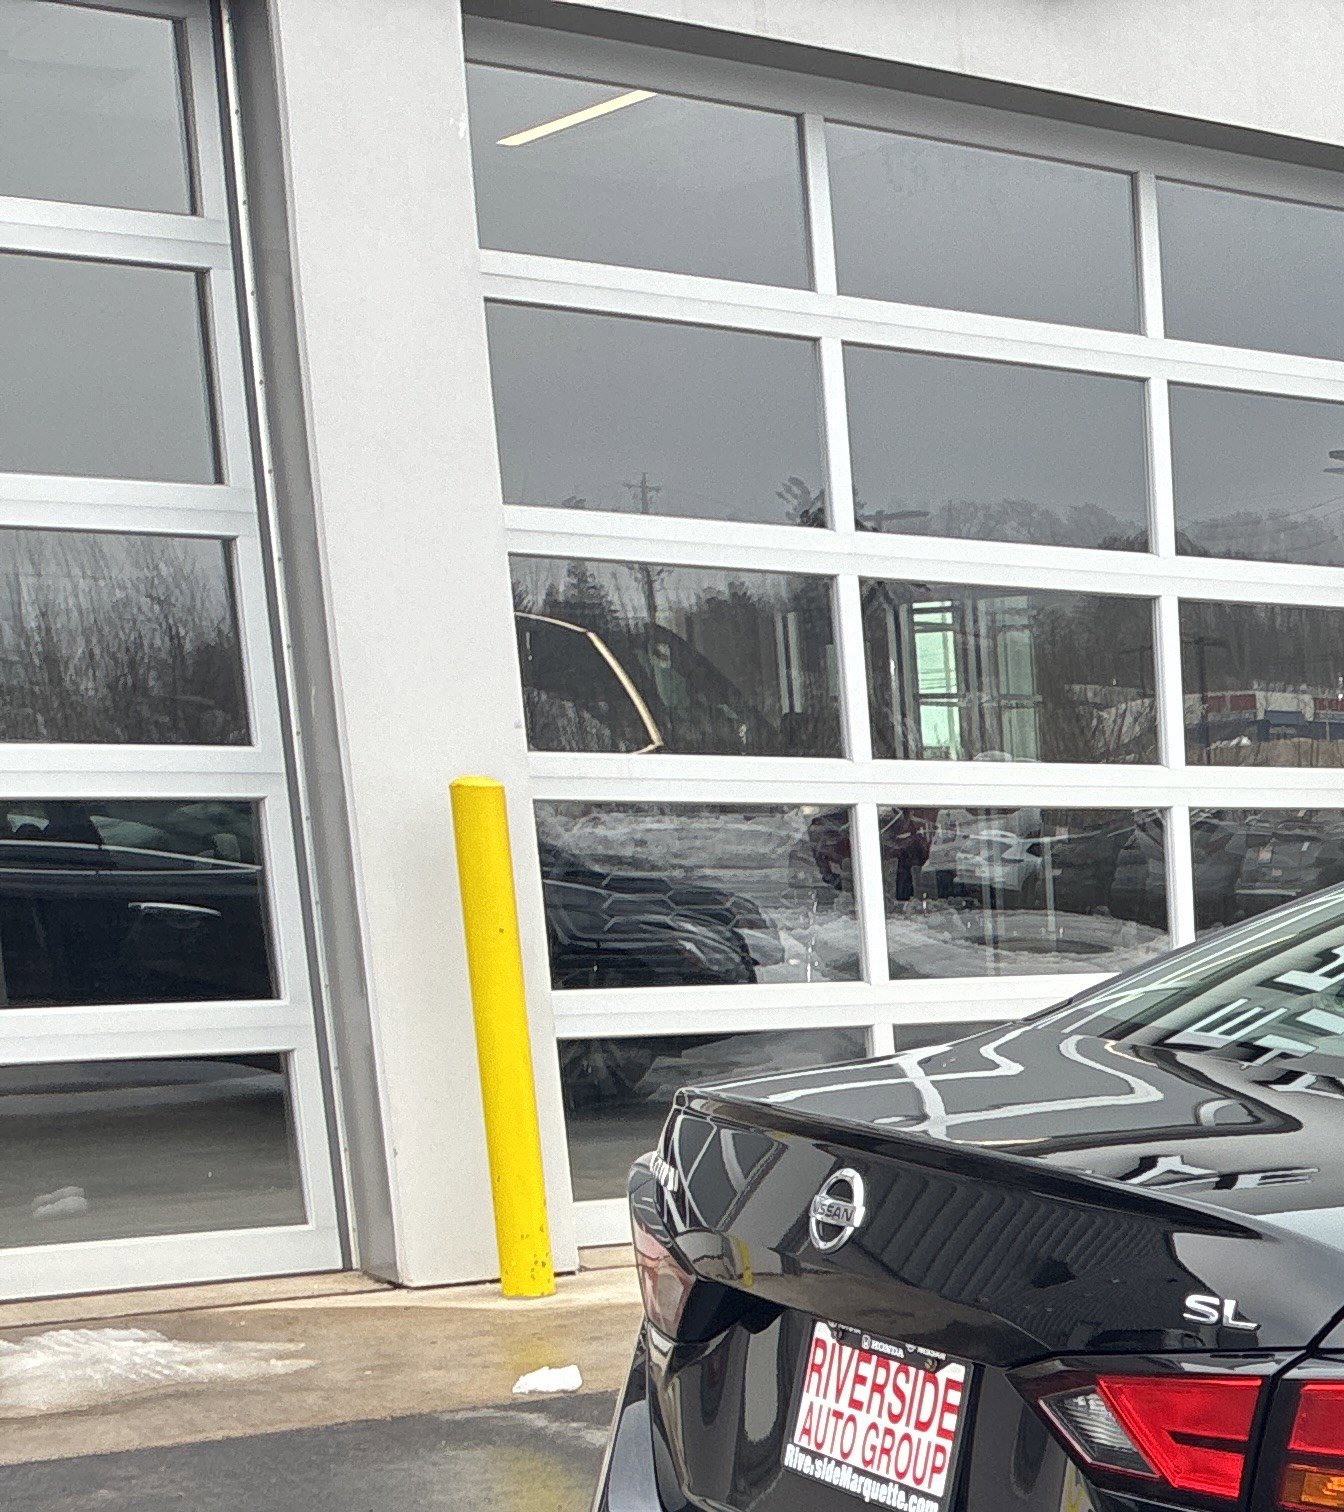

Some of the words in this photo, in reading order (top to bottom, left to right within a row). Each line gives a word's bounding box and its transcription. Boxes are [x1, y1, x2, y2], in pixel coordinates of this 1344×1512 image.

[1182, 1294, 1258, 1331] SL
[806, 1337, 964, 1441] RIVERSIDE
[798, 1401, 857, 1460] AUTO
[861, 1422, 947, 1490] GROUP
